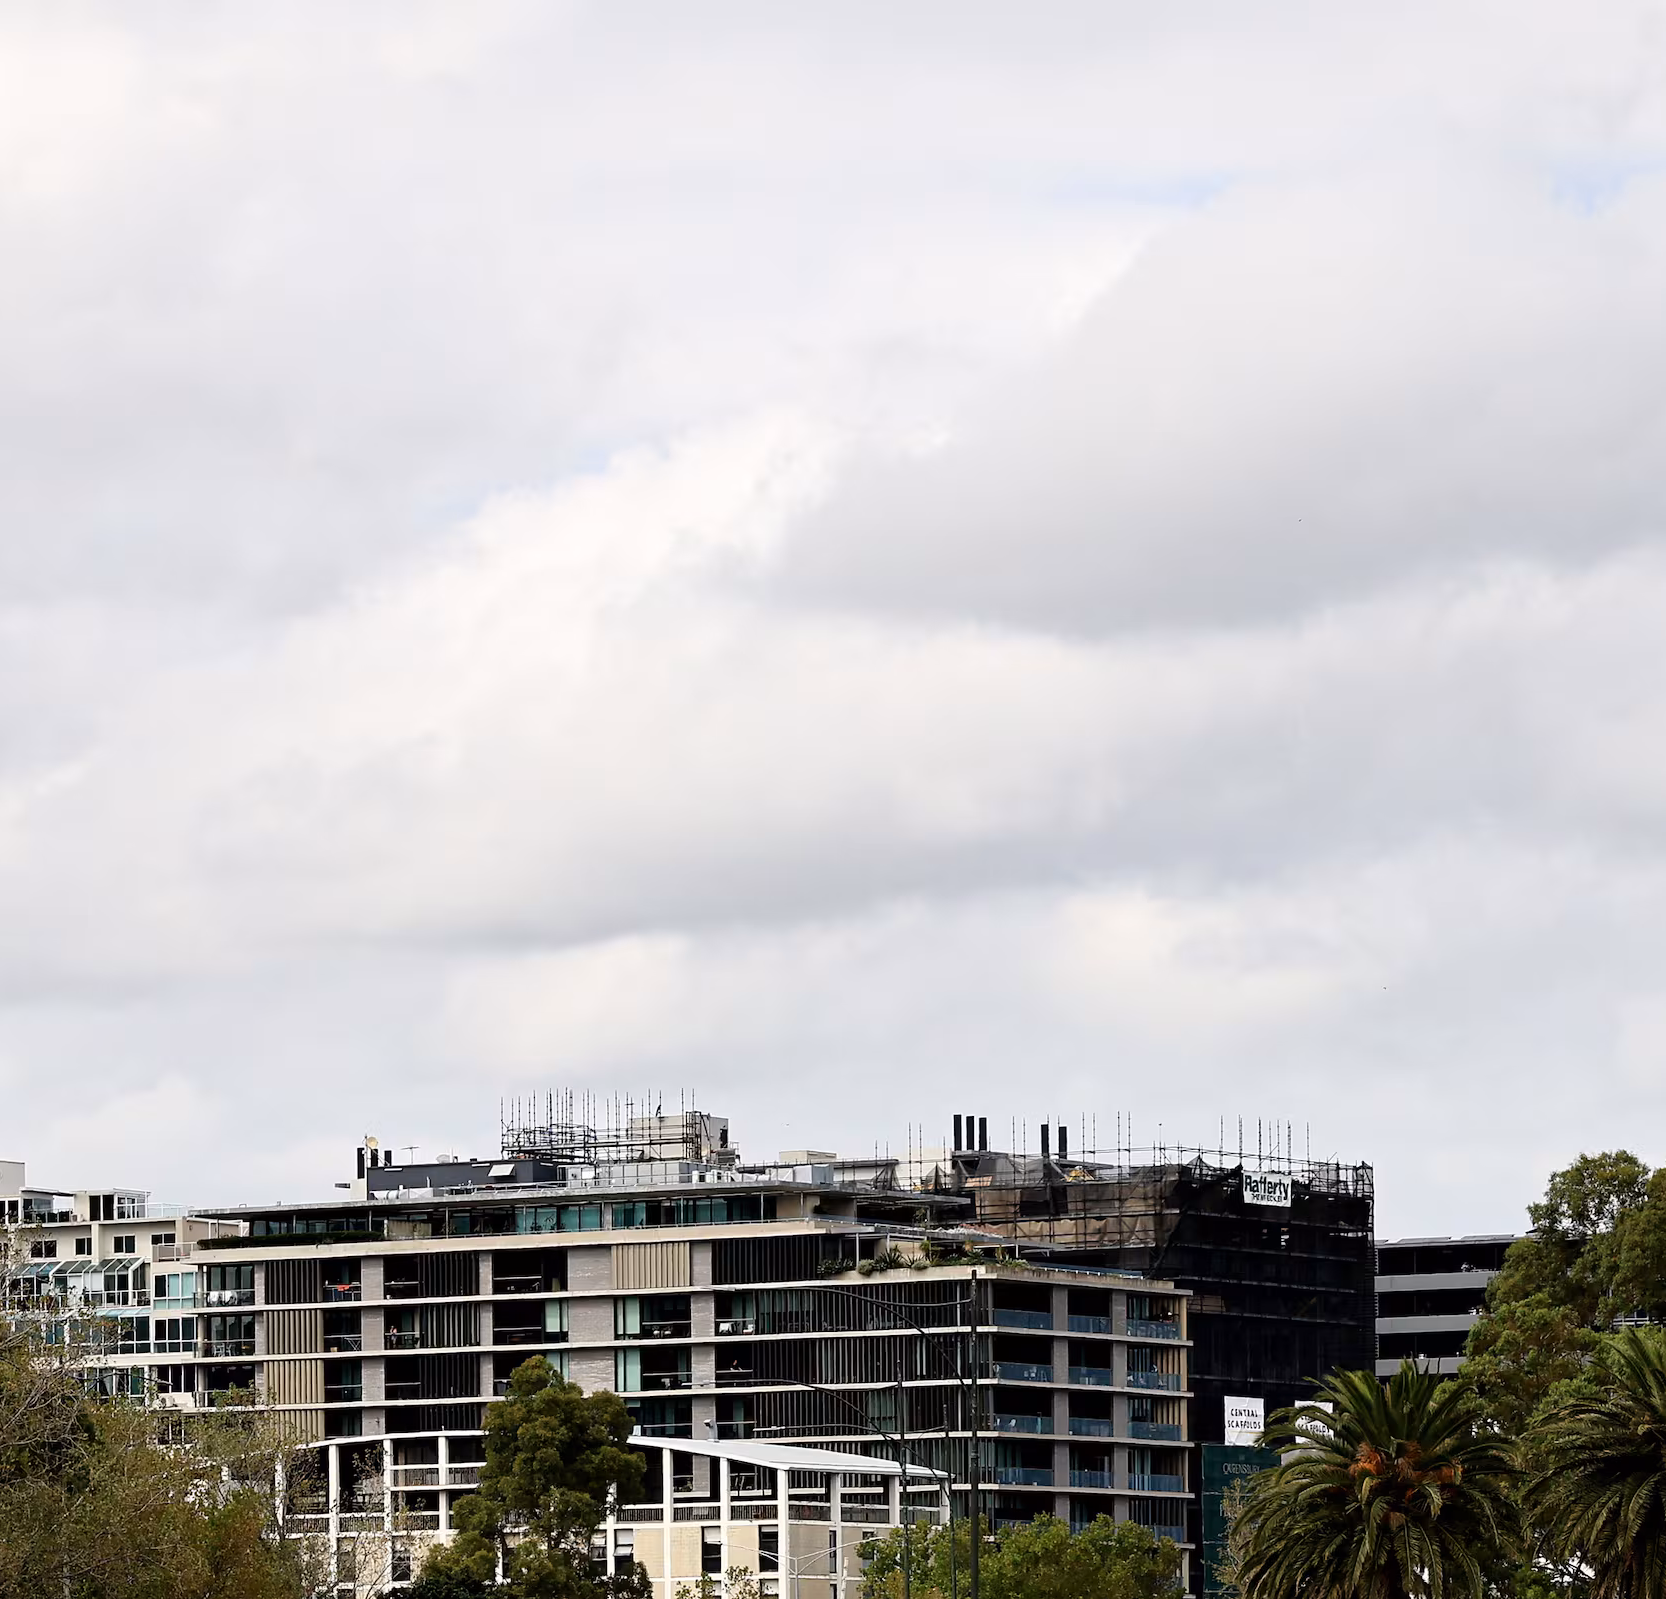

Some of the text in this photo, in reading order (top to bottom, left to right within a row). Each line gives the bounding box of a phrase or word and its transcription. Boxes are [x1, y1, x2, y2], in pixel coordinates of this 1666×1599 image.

[1244, 1175, 1290, 1201] Rafferty
[1230, 1408, 1259, 1418] CENTRAL
[1227, 1419, 1261, 1430] SCAFFOLDS
